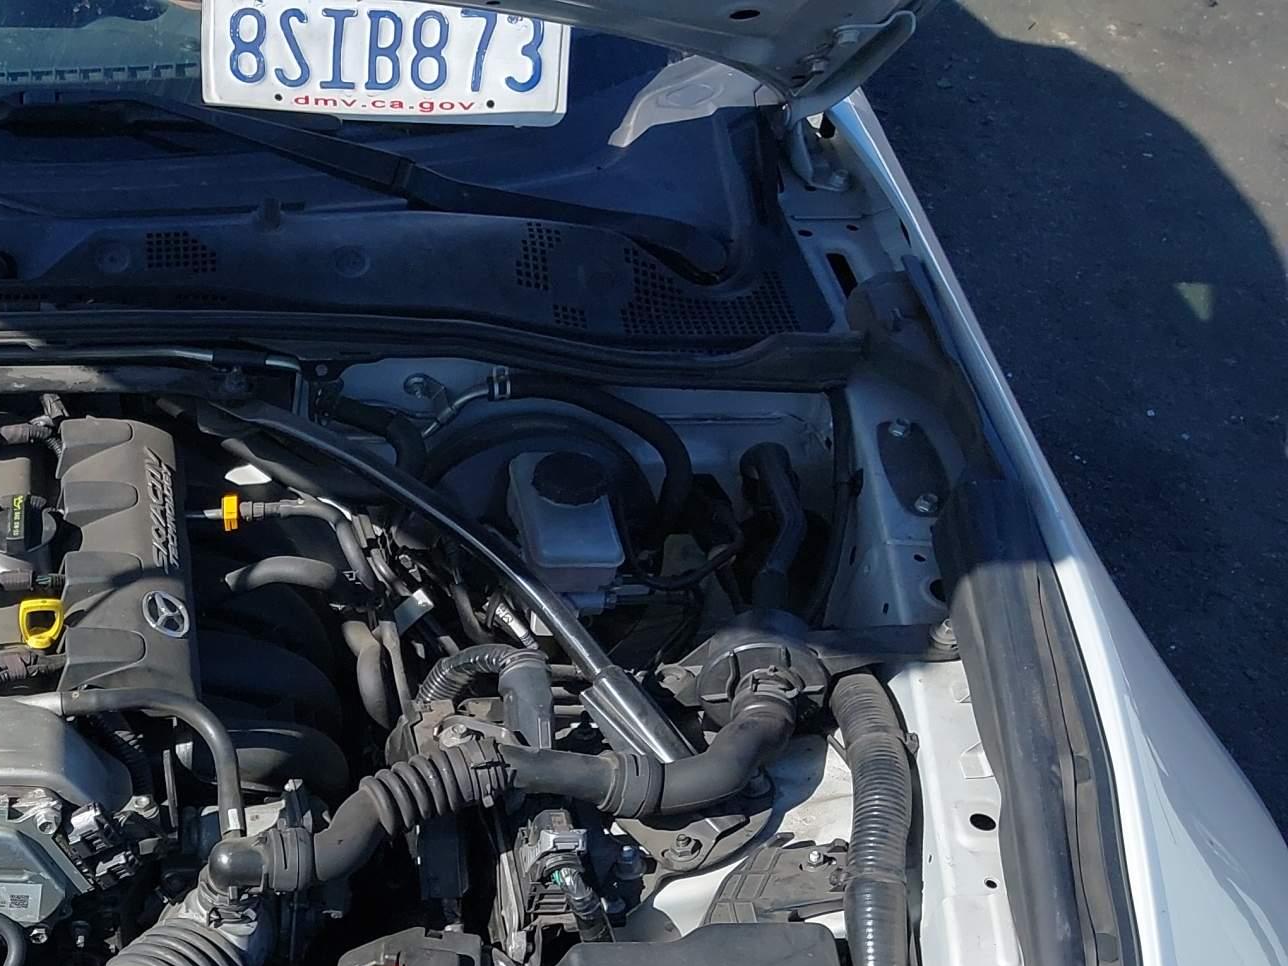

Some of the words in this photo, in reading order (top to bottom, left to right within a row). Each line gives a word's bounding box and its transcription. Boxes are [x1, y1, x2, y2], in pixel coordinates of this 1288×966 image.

[229, 7, 545, 93] 8SIB873
[294, 94, 476, 113] dmv.ca.gov
[144, 446, 169, 575] SKYACTIV
